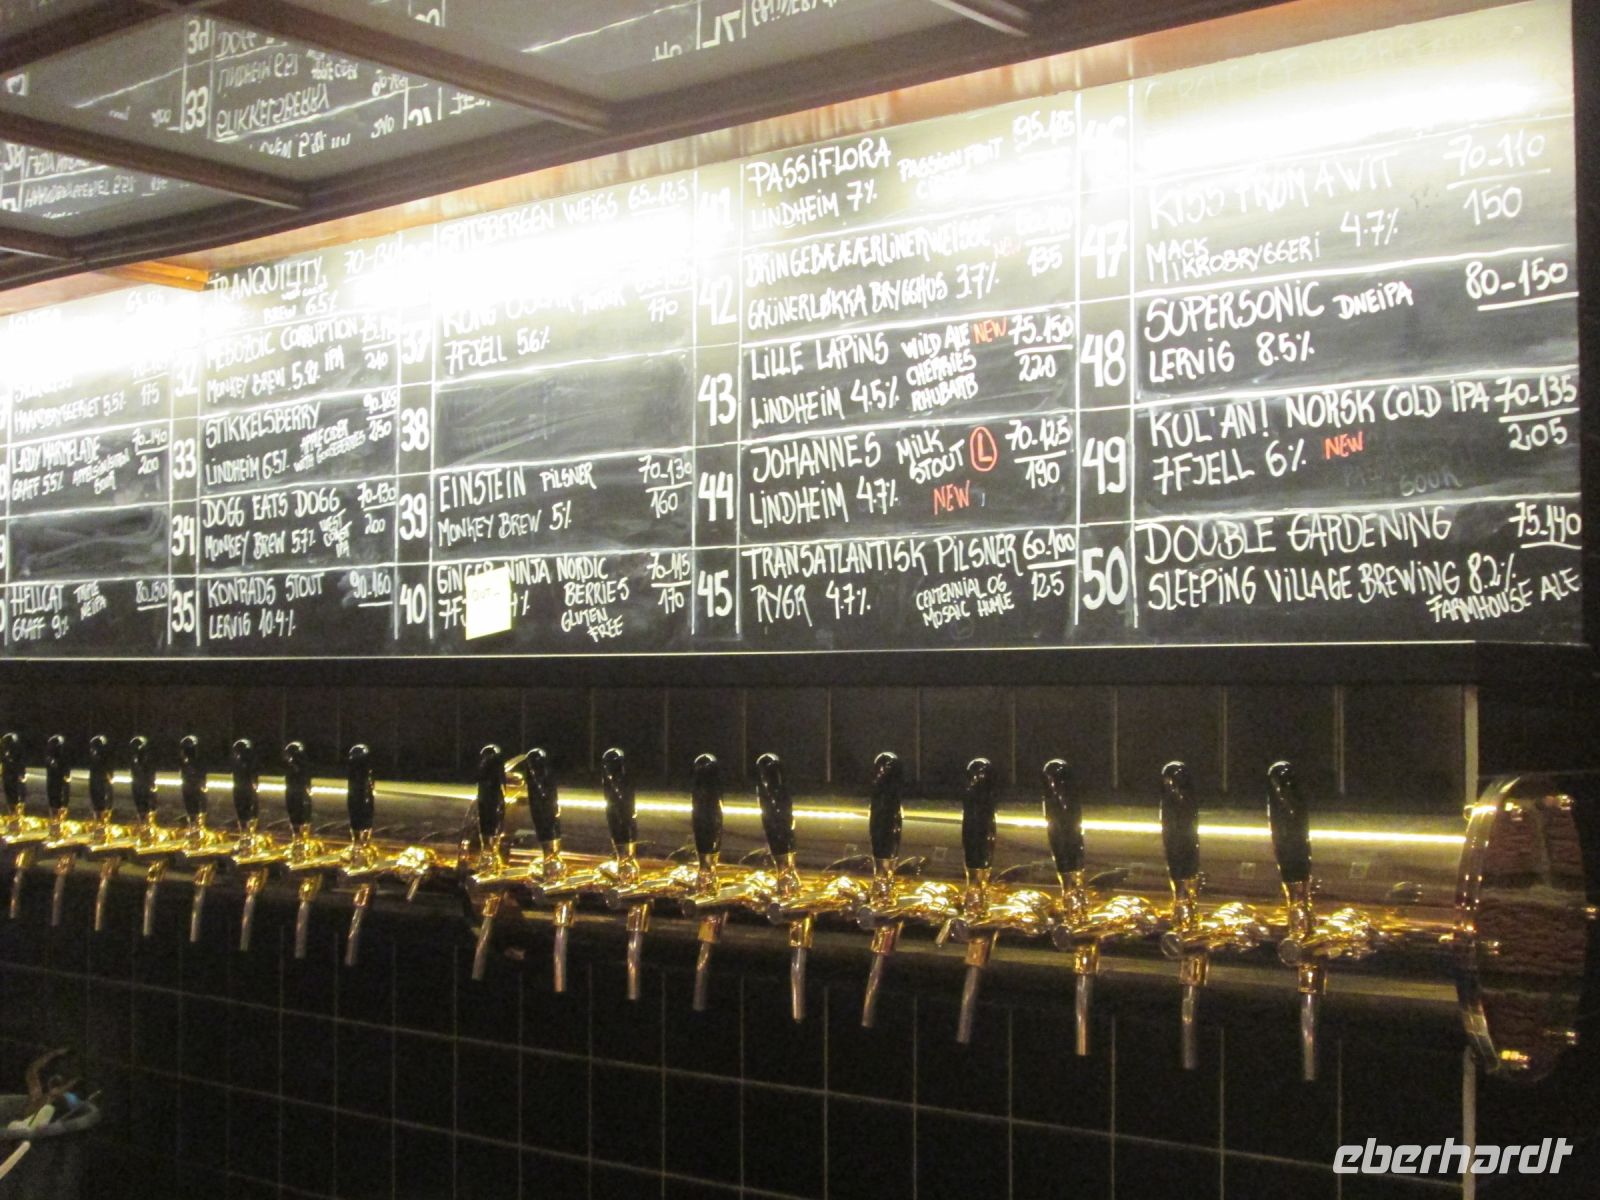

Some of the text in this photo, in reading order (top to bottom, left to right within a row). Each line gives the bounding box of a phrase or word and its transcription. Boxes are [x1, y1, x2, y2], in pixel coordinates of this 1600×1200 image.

[746, 135, 892, 197] PASSIFLORA
[1463, 186, 1523, 226] 150
[1079, 219, 1129, 280] 47
[697, 273, 738, 327] 42
[1465, 258, 1570, 301] 80-150
[1143, 279, 1326, 344] SUPERSONIC
[750, 332, 890, 382] LILLE LAPINS
[901, 316, 1008, 360] WILD ALE NEW
[1080, 328, 1127, 388] 48
[1150, 330, 1316, 383] LERVIG 8.5%
[1018, 353, 1057, 383] 220
[699, 373, 737, 427] 43
[1285, 387, 1378, 430] NORSK
[1382, 383, 1442, 424] COLD
[205, 400, 321, 449] STIKKELSBERRY
[400, 407, 430, 452] 38
[1321, 430, 1366, 461] NEW
[1507, 417, 1568, 451] 205
[172, 437, 197, 481] 33
[750, 431, 882, 483] JOHANNES
[895, 429, 945, 466] MILK
[909, 438, 966, 486] STOUT
[1081, 435, 1128, 496] 49
[1152, 447, 1256, 496] 7FJELL
[1265, 437, 1307, 478] 6%
[439, 461, 598, 514] EINSTEIN PILSNER
[697, 470, 735, 522] 44
[1025, 459, 1061, 490] 190
[251, 490, 289, 522] EATS
[399, 492, 428, 540] 39
[649, 493, 679, 519] 160
[932, 479, 972, 516] NEW
[171, 514, 196, 557] 34
[364, 512, 387, 535] 200
[438, 499, 573, 547] MONKEY BREW 5%
[1135, 505, 1453, 566] DOUBLE GARDENING
[252, 530, 285, 561] BREW
[556, 554, 609, 581] NORDIC
[741, 532, 1024, 580] TRANSATLANTISK PILSNER
[207, 571, 326, 608] KONRADS STOUT
[563, 577, 631, 607] BERRIES
[697, 569, 734, 618] 45
[1030, 570, 1066, 602] 125
[1081, 545, 1130, 611] 50
[1147, 551, 1518, 612] SLEEPING VILLAGE BREWING 8.2%
[1539, 566, 1581, 602] ALE
[171, 589, 196, 633] 35
[400, 583, 428, 625] 40
[658, 587, 685, 615] 170
[586, 615, 624, 643] FREE
